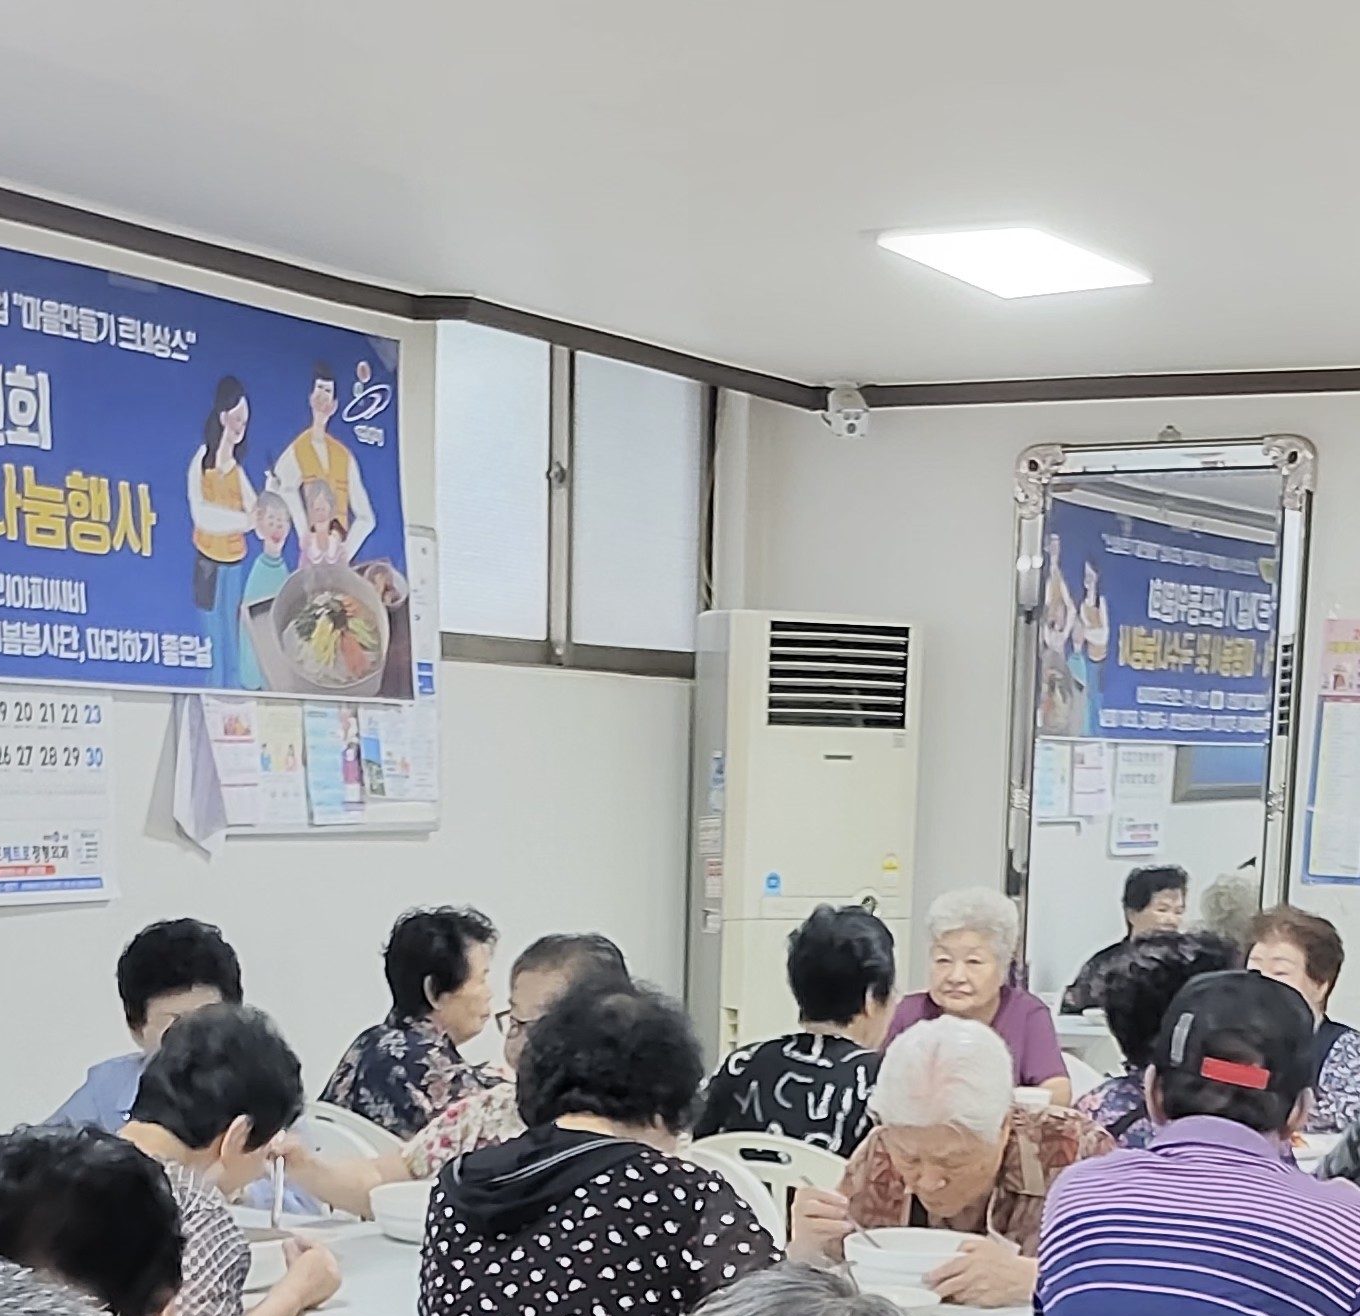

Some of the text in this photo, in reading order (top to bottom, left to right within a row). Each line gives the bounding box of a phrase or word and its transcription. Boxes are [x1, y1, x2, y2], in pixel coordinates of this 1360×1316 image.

[86, 628, 159, 665] 머리하기
[14, 701, 33, 722] 20
[39, 702, 55, 723] 21
[61, 703, 78, 724] 22
[84, 704, 102, 724] 23
[16, 745, 33, 767] 27
[40, 746, 58, 767] 28
[63, 747, 80, 767] 29
[86, 747, 104, 768] 30
